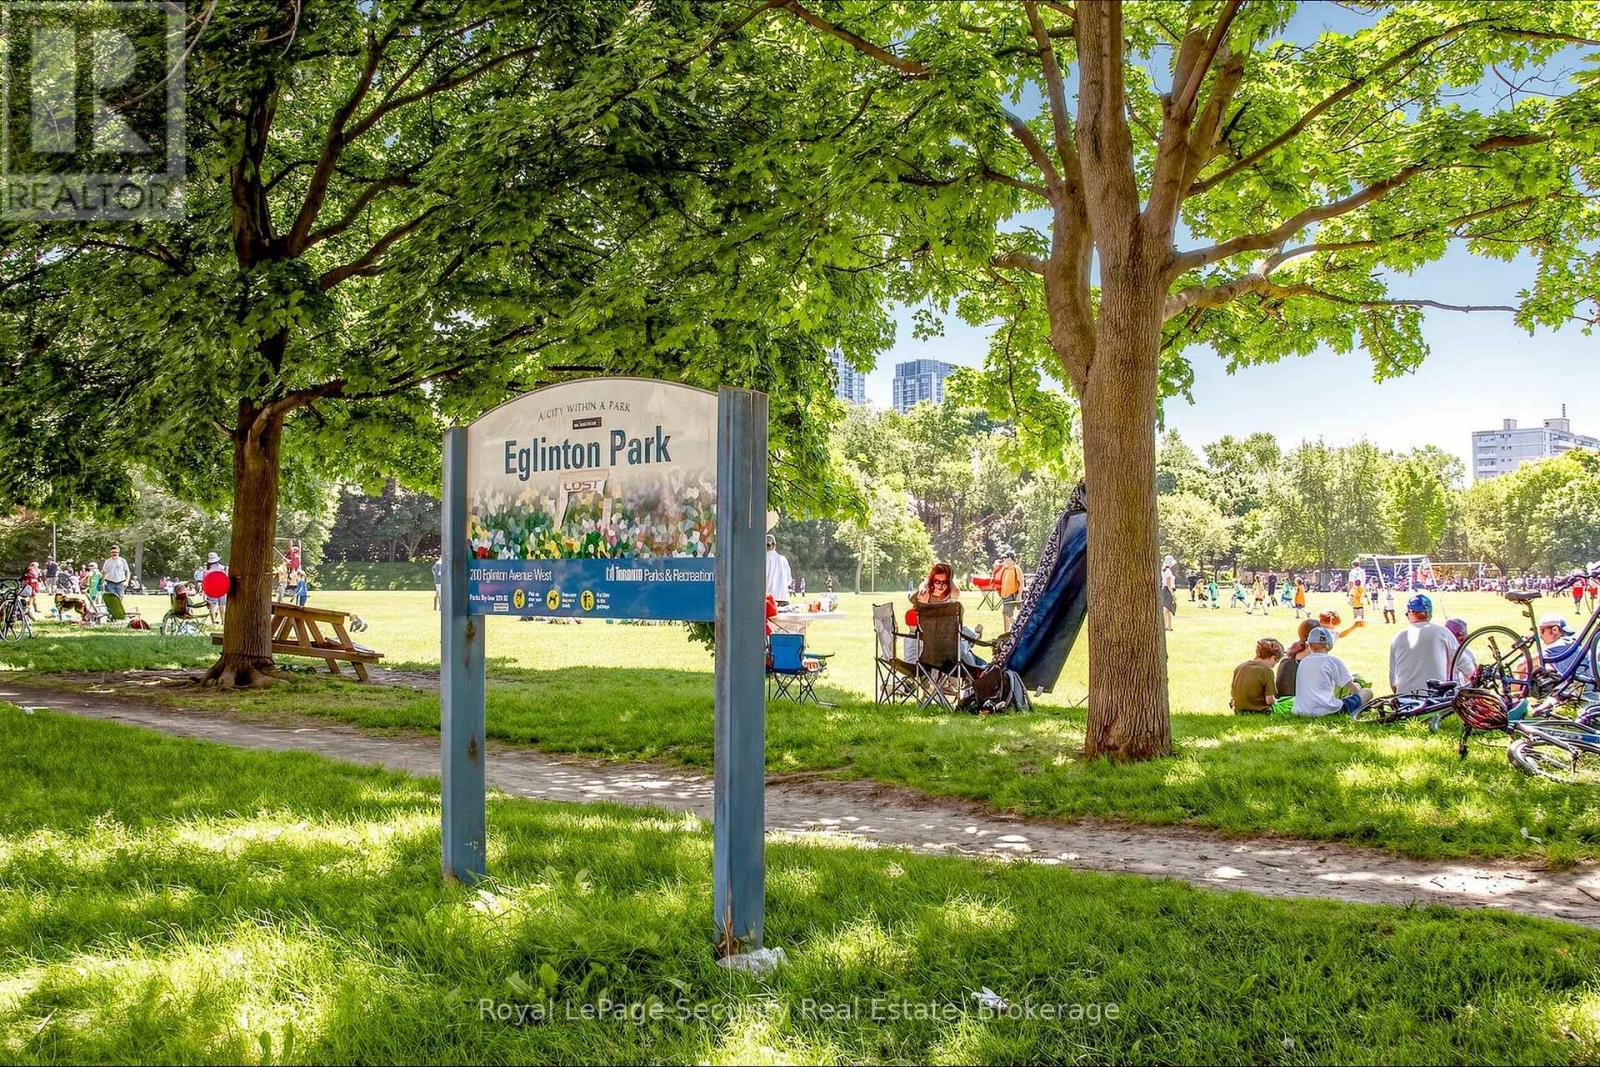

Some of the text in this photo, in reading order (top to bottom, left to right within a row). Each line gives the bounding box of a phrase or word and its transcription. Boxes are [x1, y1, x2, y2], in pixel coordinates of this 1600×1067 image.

[546, 407, 563, 419] CITY
[566, 401, 596, 413] WITHIN
[600, 400, 606, 410] A
[608, 401, 631, 412] PARK
[505, 425, 672, 481] Eglinton Park
[564, 481, 597, 491] LOST
[470, 569, 482, 581] 200
[509, 569, 532, 581] Avenue
[533, 568, 552, 581] West
[644, 568, 664, 581] Parks
[665, 568, 673, 581] &
[673, 568, 715, 581] Recreation
